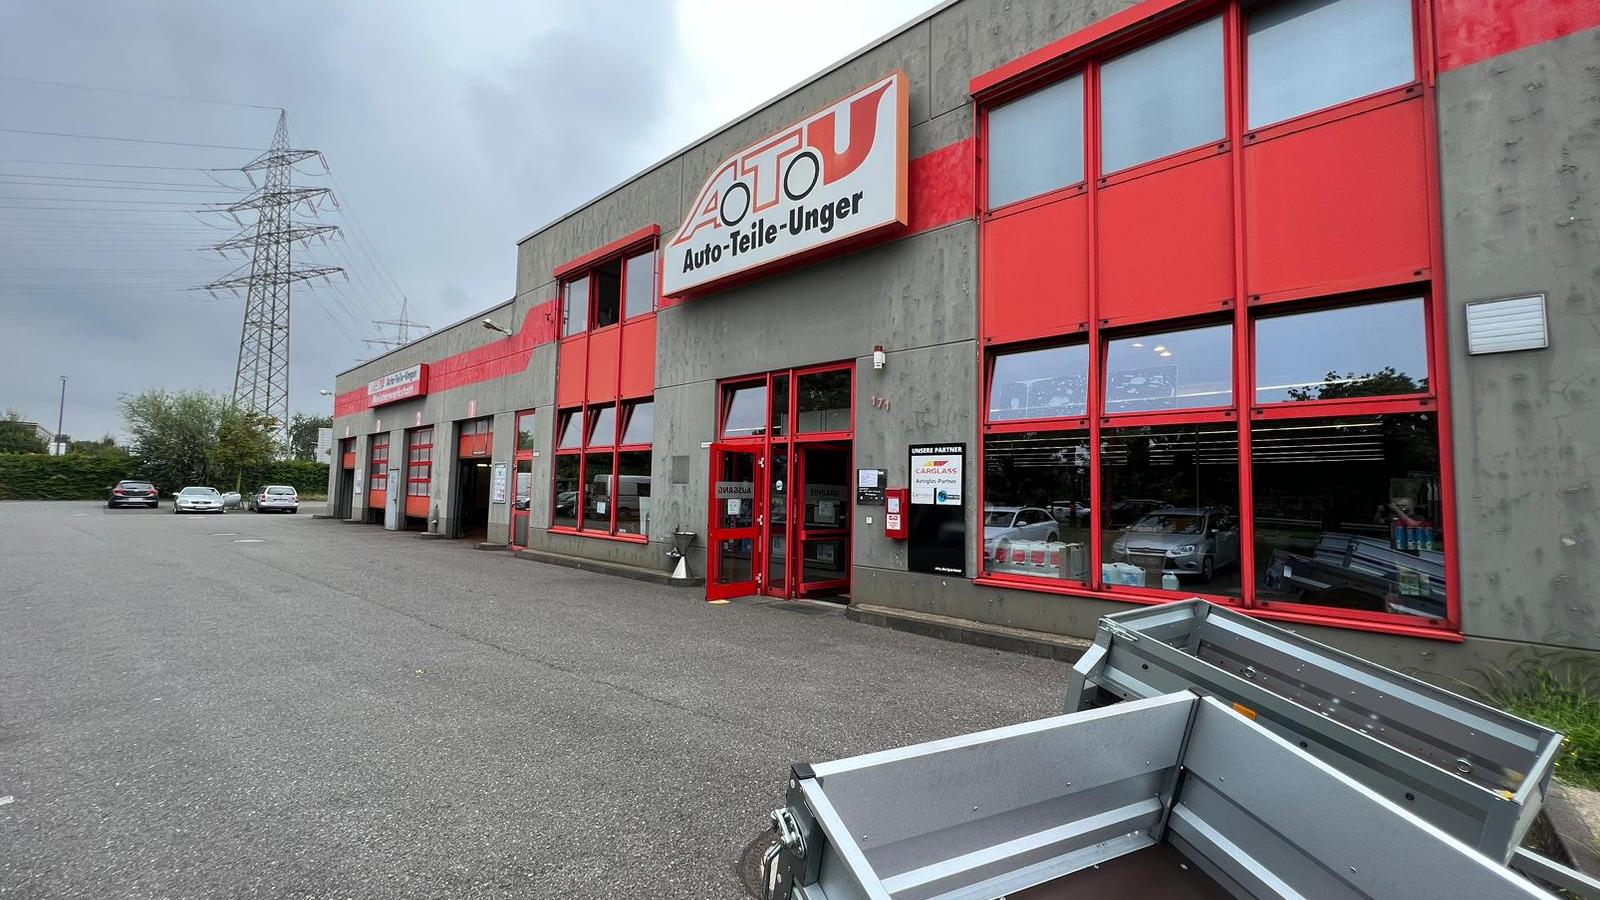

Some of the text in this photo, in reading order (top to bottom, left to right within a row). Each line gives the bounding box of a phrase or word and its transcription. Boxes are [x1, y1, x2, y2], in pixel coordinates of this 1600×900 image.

[672, 79, 893, 246] ATU
[682, 191, 863, 273] Auto-Teile-Unger
[871, 395, 890, 412] 171
[915, 467, 958, 475] CARGLASS
